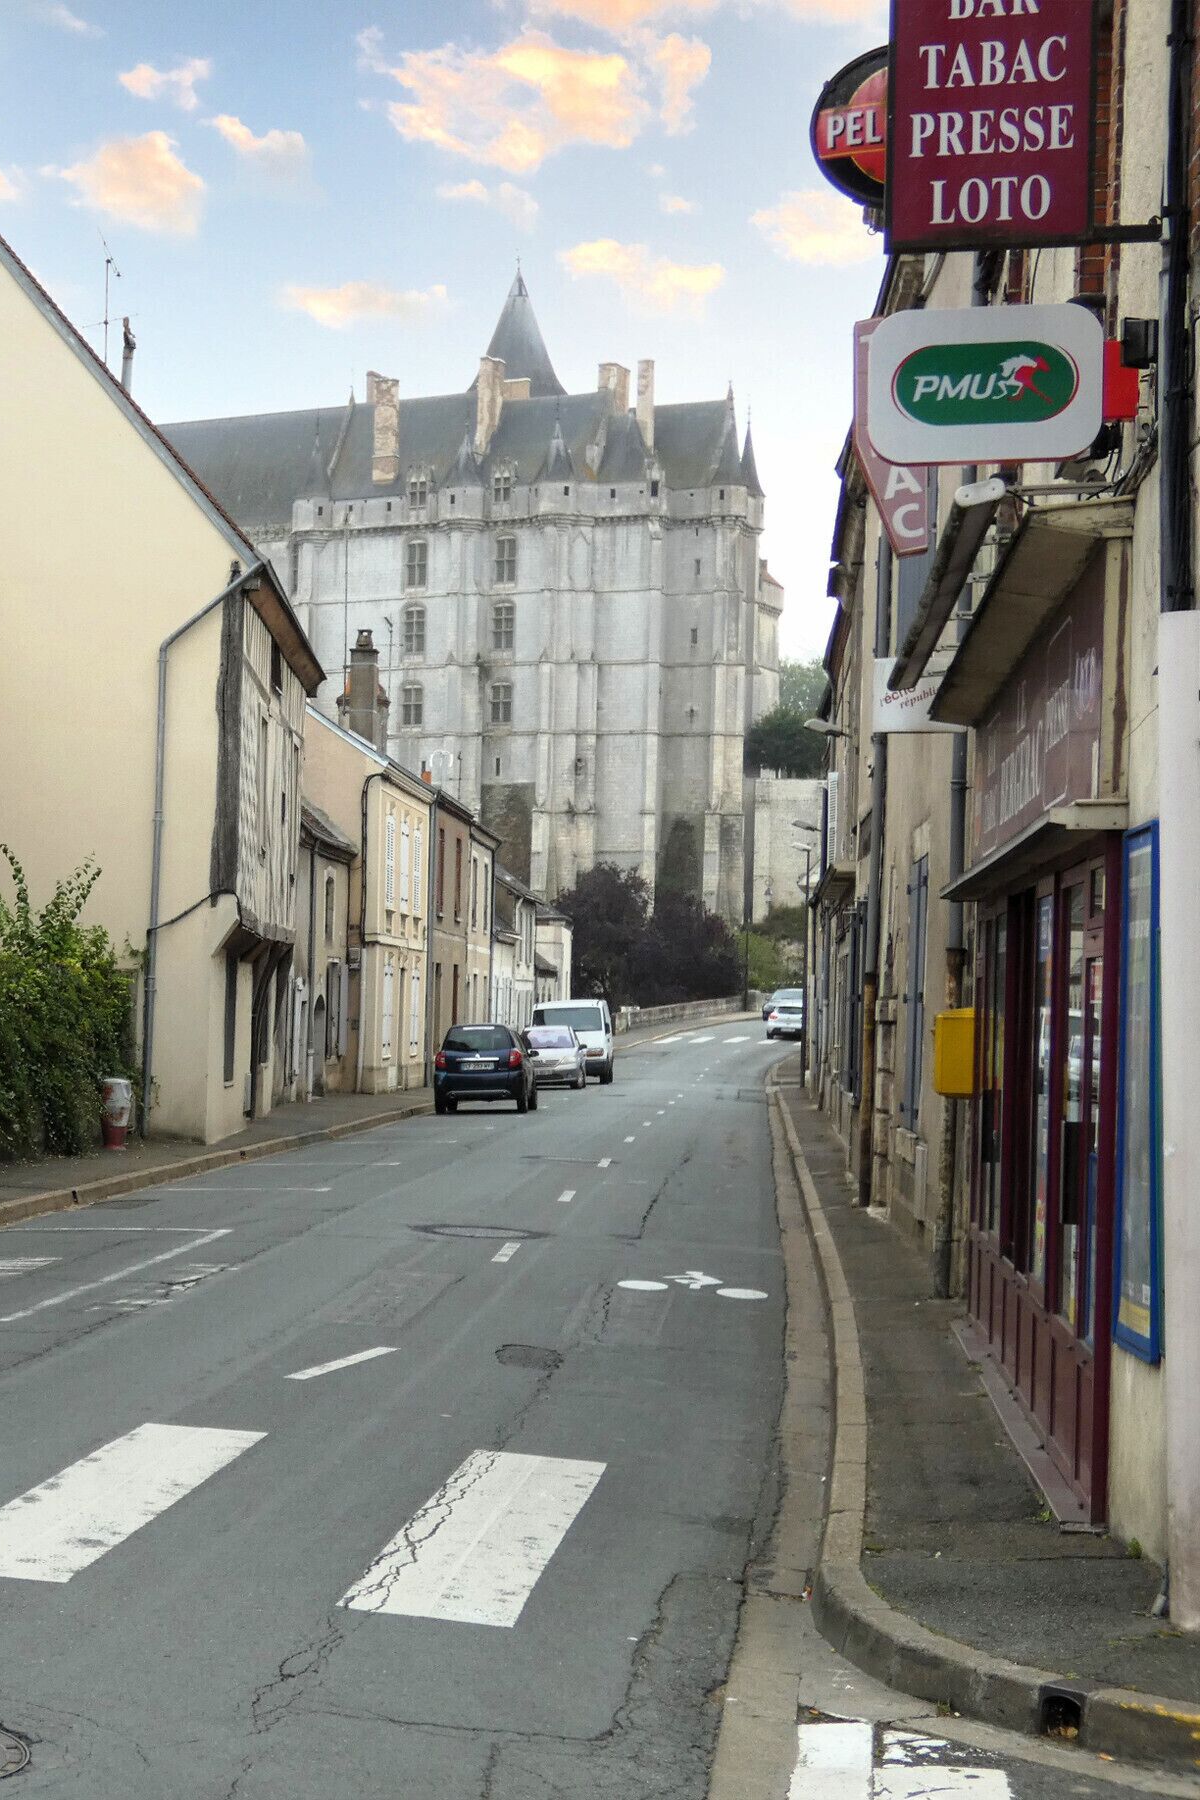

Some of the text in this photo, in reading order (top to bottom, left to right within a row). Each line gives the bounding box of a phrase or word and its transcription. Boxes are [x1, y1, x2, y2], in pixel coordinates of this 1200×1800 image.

[918, 35, 1068, 89] TABAC
[826, 107, 882, 150] PEL
[909, 104, 1075, 158] PRESSE
[929, 174, 1052, 225] LOTO
[912, 372, 999, 403] PMU
